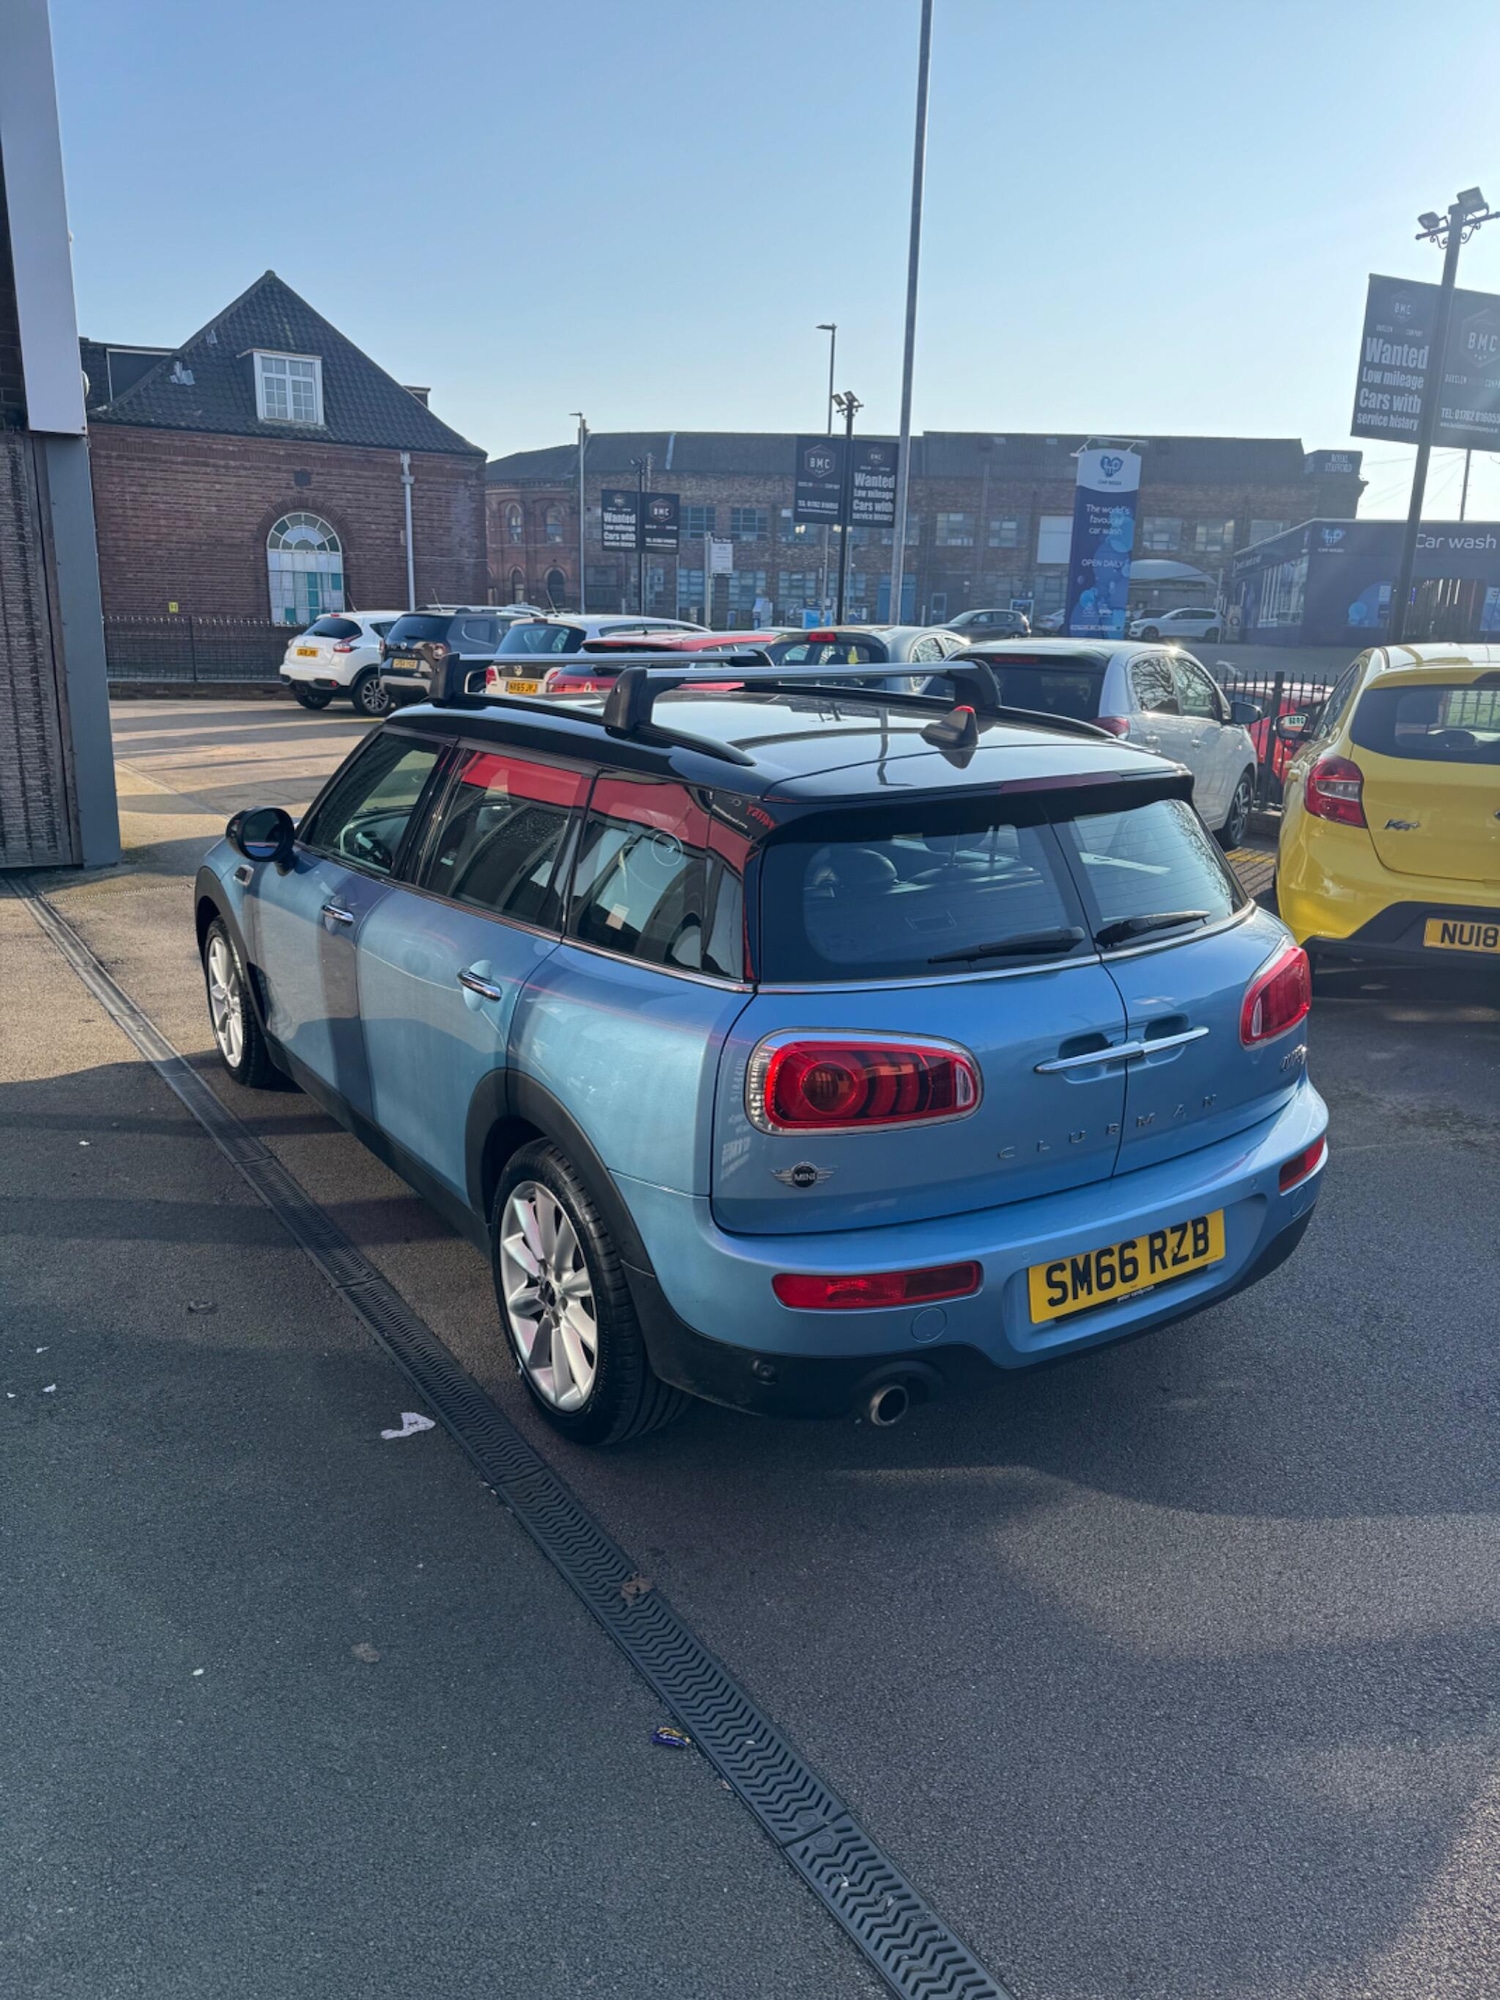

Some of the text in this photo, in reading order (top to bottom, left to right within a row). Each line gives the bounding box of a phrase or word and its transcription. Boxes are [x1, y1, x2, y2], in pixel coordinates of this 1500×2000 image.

[1468, 332, 1499, 352] BMC
[1365, 336, 1430, 369] Wanted
[1362, 367, 1425, 390] Low mileage
[1359, 388, 1422, 414] Cars with
[1356, 411, 1419, 431] service history
[809, 457, 831, 469] BMC
[854, 472, 896, 489] Wanted
[853, 499, 873, 511] Cars
[1086, 504, 1101, 513] The
[1088, 527, 1101, 535] car
[1415, 533, 1497, 549] Car wash
[1081, 558, 1124, 569] OPEN DAILY
[1440, 922, 1499, 948] NU18
[998, 1094, 1217, 1160] CLUBMAN
[1045, 1215, 1210, 1307] SM66 RZB
